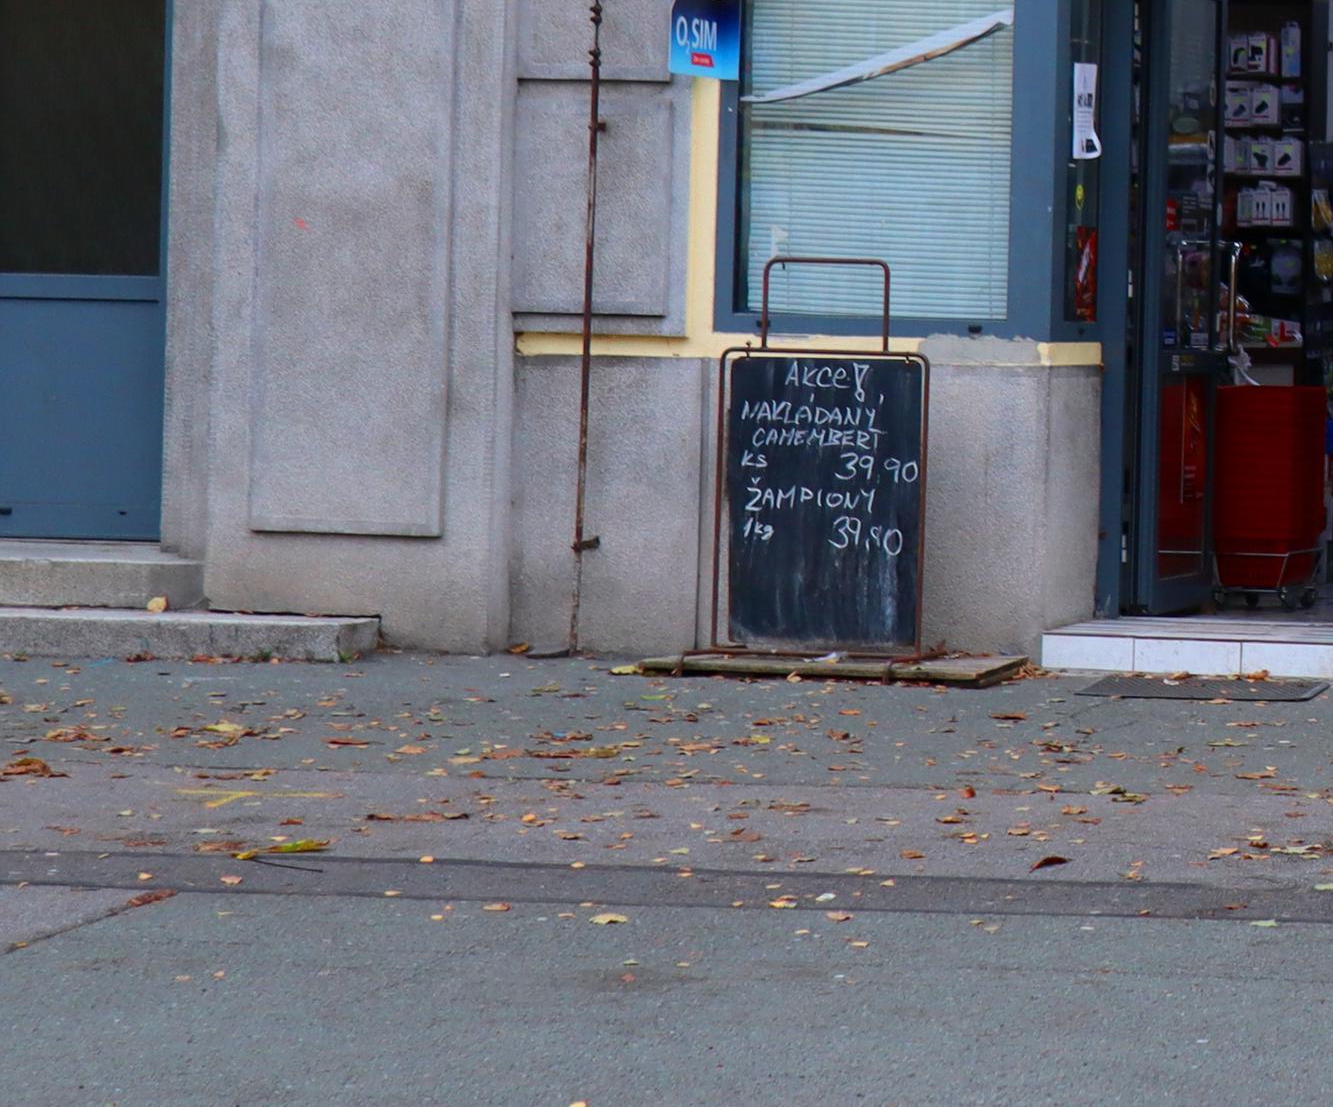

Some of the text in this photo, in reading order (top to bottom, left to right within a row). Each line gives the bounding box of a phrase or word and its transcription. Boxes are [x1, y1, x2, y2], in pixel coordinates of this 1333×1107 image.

[691, 19, 718, 52] SIM
[740, 393, 885, 434] NAKLÁDANÝ
[751, 426, 883, 451] CAMEMBERT
[744, 476, 877, 514] ŽAMPIONY
